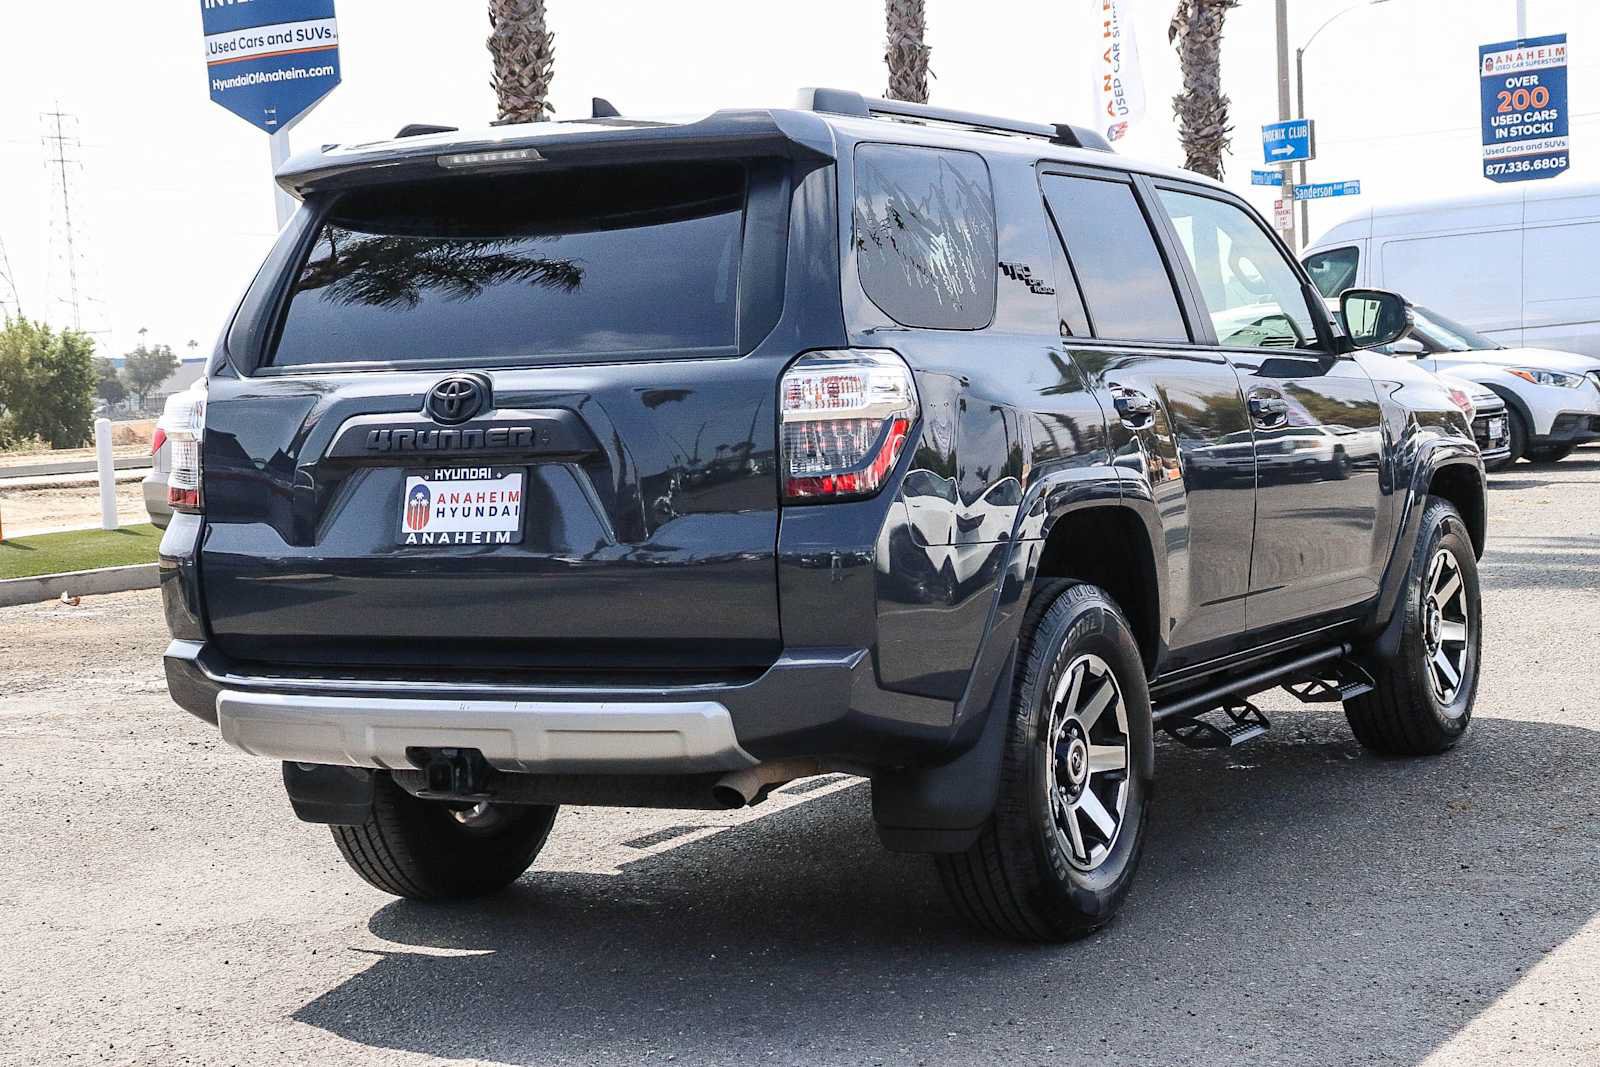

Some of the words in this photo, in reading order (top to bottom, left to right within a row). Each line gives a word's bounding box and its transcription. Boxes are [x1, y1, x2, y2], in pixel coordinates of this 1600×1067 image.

[210, 39, 236, 55] Used
[239, 36, 264, 49] Cars
[267, 30, 292, 45] and
[296, 27, 331, 42] SUVs
[1495, 47, 1566, 65] ANAHEIM
[1495, 63, 1511, 72] USED
[1512, 61, 1524, 69] CAR
[212, 65, 335, 91] HyundaiOfAnaheim.com
[1505, 75, 1539, 89] OVER
[1113, 78, 1128, 116] USED
[1497, 86, 1550, 113] 200
[1491, 113, 1522, 127] USED
[1523, 109, 1558, 123] CARS
[1289, 125, 1308, 139] CLUB
[1495, 127, 1508, 139] IN
[1509, 122, 1554, 137] STOCK!
[1485, 146, 1505, 156] Used
[1506, 143, 1524, 153] Cars
[1526, 141, 1543, 151] and
[1544, 139, 1566, 149] SUVs
[1485, 156, 1567, 176] 877.336.6805
[1295, 185, 1333, 199] Sanderson
[366, 427, 535, 451] 4RUNNER
[434, 467, 492, 481] HYUNDAI
[436, 490, 520, 505] ANAHEIM
[436, 505, 518, 518] HYUNDAI
[405, 531, 511, 545] ANAHEIM
